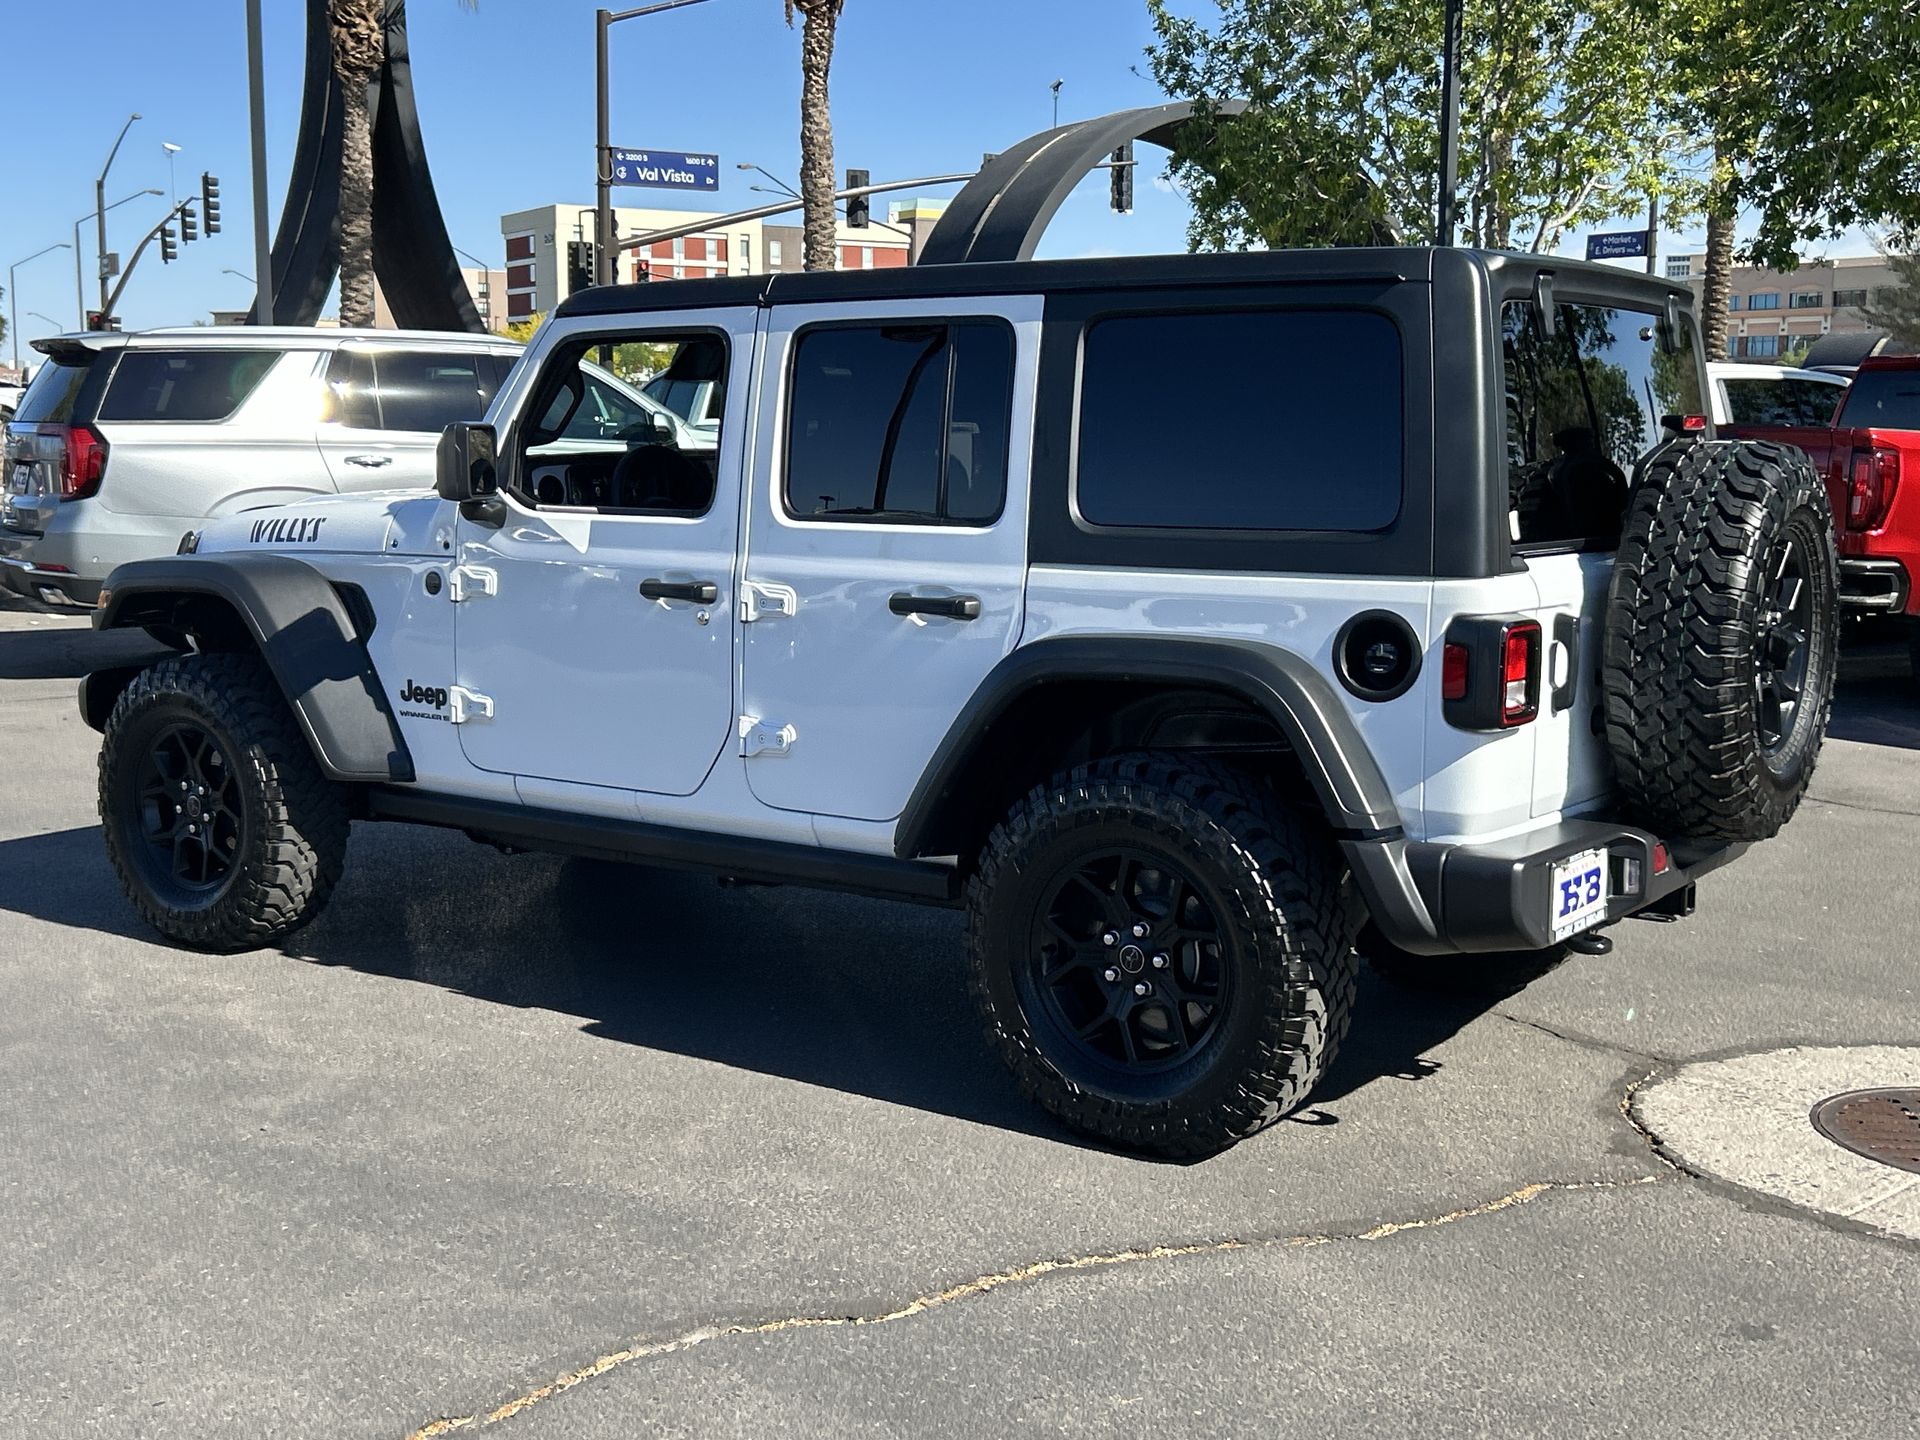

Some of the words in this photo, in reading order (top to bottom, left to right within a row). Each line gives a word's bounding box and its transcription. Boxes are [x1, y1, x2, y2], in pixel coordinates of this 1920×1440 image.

[625, 153, 642, 161] 3200
[685, 157, 700, 165] 1600
[701, 158, 706, 166] E
[636, 166, 658, 181] Val
[660, 168, 694, 183] Vista
[1607, 235, 1632, 244] Market
[1602, 246, 1626, 255] Drivers
[250, 517, 328, 543] WILLYS
[400, 679, 448, 710] Jeep
[400, 710, 442, 721] WRANGLER
